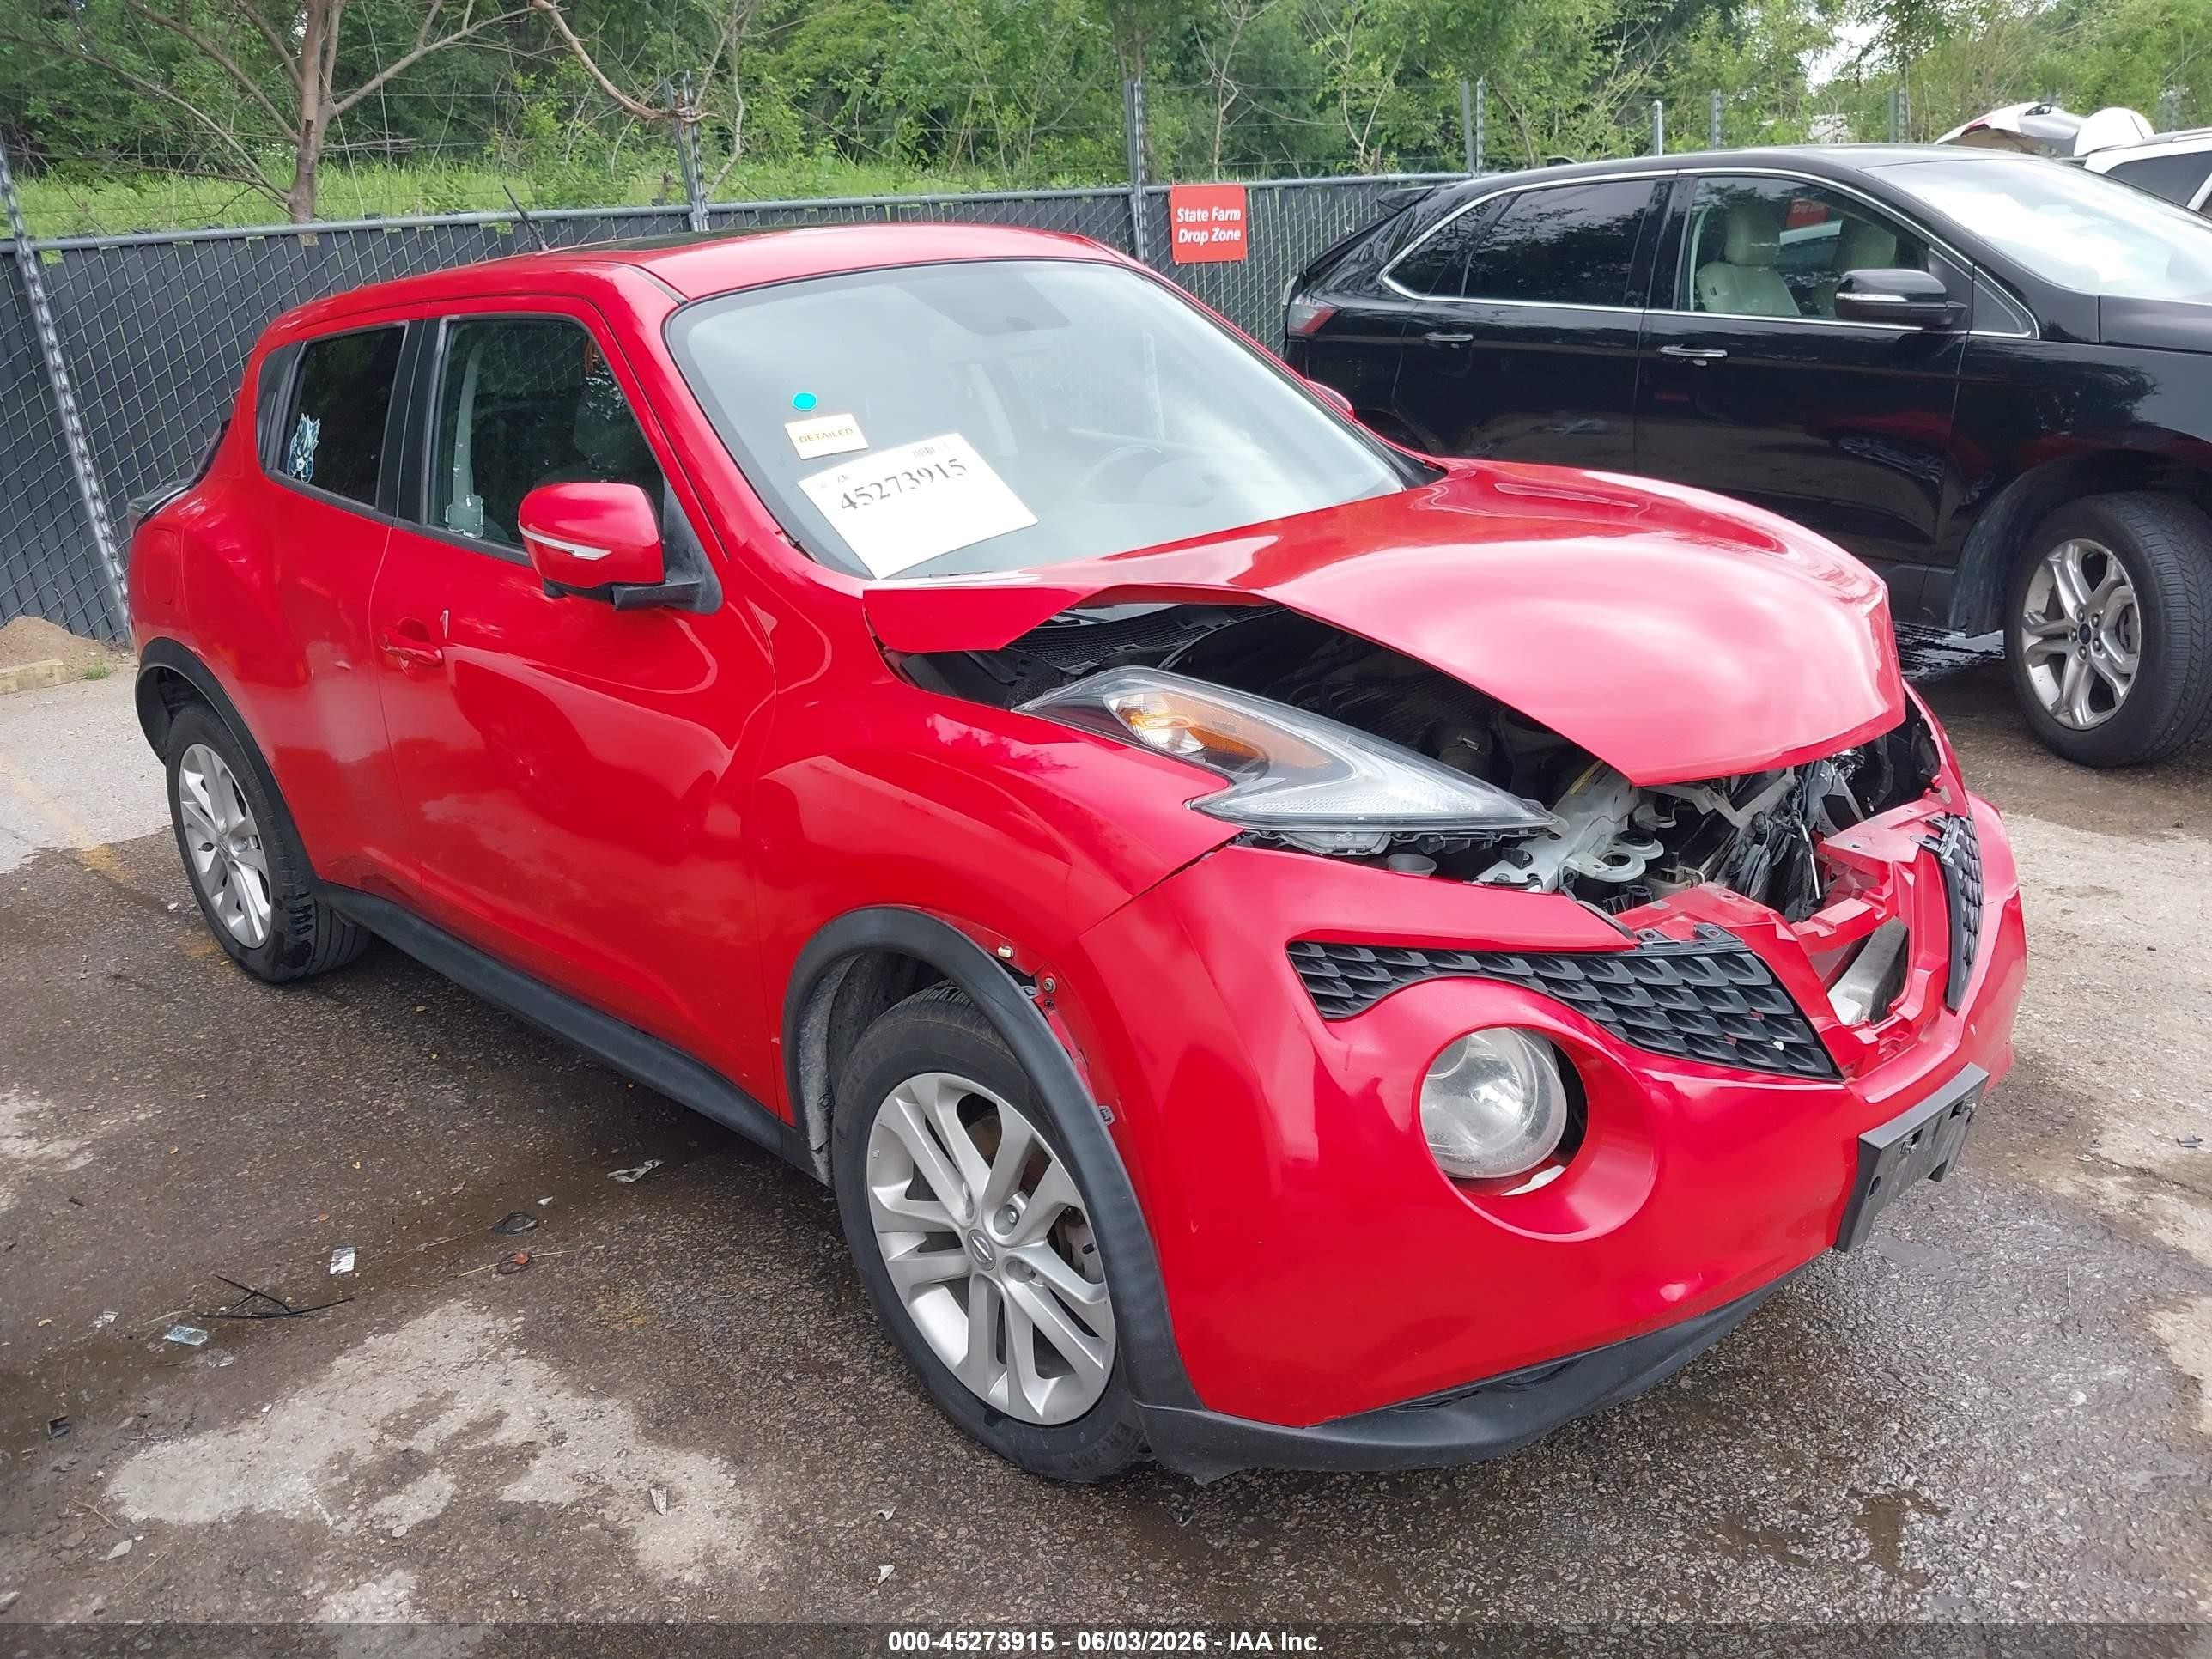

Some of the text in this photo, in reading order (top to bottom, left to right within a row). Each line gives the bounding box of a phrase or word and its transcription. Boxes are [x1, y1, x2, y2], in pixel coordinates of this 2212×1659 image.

[1176, 206, 1242, 222] State Farm
[1178, 227, 1242, 246] Drop Zone
[798, 428, 854, 443] DETAILED
[841, 458, 969, 510] 45273915
